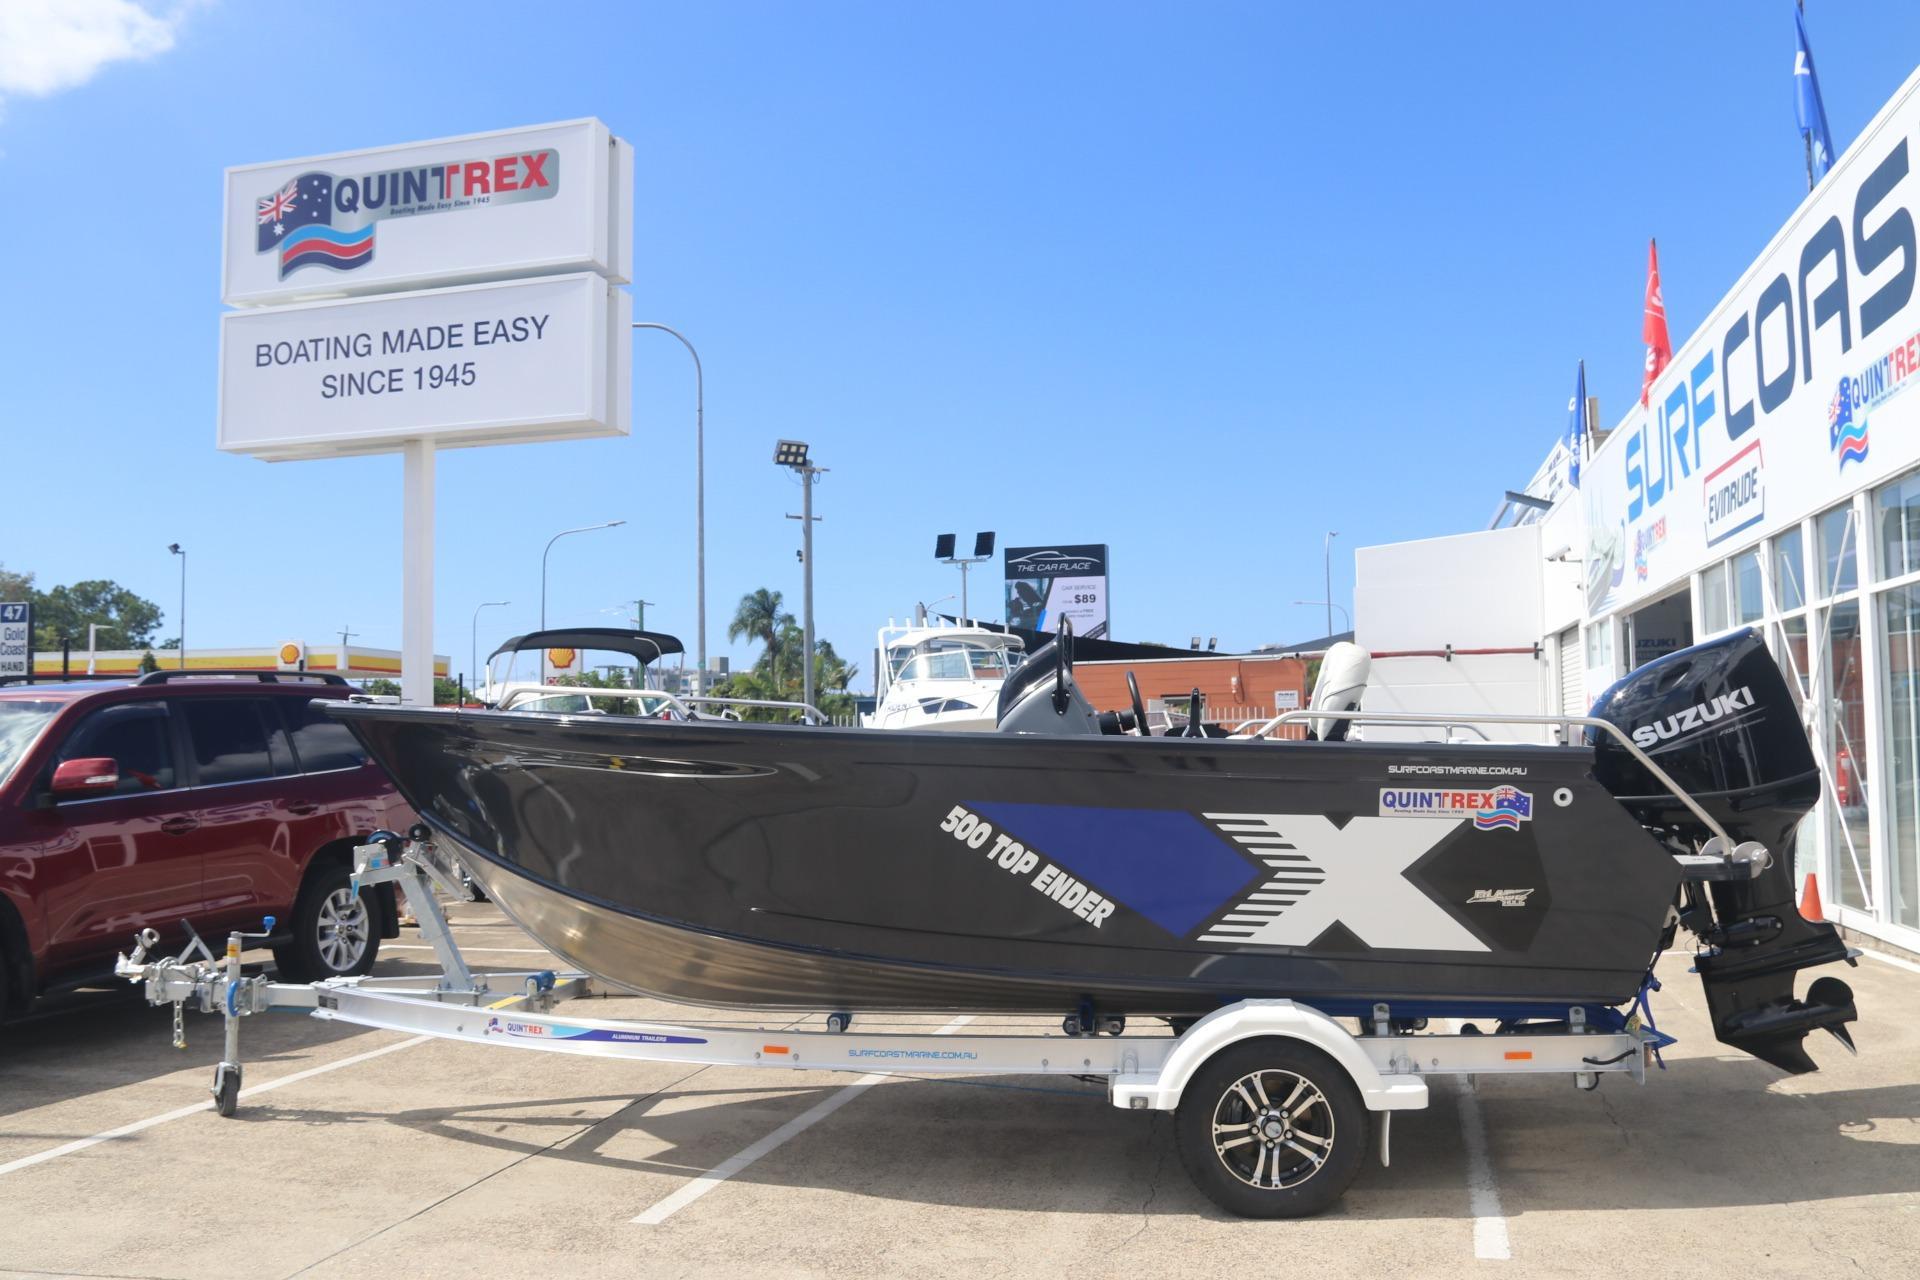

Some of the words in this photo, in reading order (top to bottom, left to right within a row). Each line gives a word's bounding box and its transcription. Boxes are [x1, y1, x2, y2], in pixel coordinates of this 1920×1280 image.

[334, 152, 550, 213] QUINTREX
[417, 203, 435, 212] Made
[437, 201, 452, 210] Easy
[454, 199, 471, 207] Since
[473, 196, 490, 205] 1945
[1625, 120, 1920, 524] SURFCOAS
[256, 333, 372, 367] BOATING
[382, 324, 464, 354] MADE
[474, 315, 550, 345] EASY
[321, 369, 404, 399] SINCE
[413, 362, 476, 391] 1945
[1709, 466, 1757, 524] EVINRUDE
[1017, 564, 1036, 572] THE
[1037, 563, 1059, 571] CAR
[1059, 562, 1092, 571] PLACE
[1074, 594, 1096, 603] $89
[4, 605, 23, 620] 47
[4, 627, 26, 640] Gold
[1632, 686, 1755, 748] SUZUKI
[1388, 765, 1527, 775] SURFCOASTMARINE.COM.AU
[1383, 791, 1494, 808] QUINTREX
[940, 805, 992, 849] 500
[987, 833, 1039, 875] TOP
[1030, 863, 1115, 928] ENDER
[507, 1022, 543, 1035] QUINTREX
[849, 1050, 977, 1059] SURFCOASTMARINE.COM.AU
